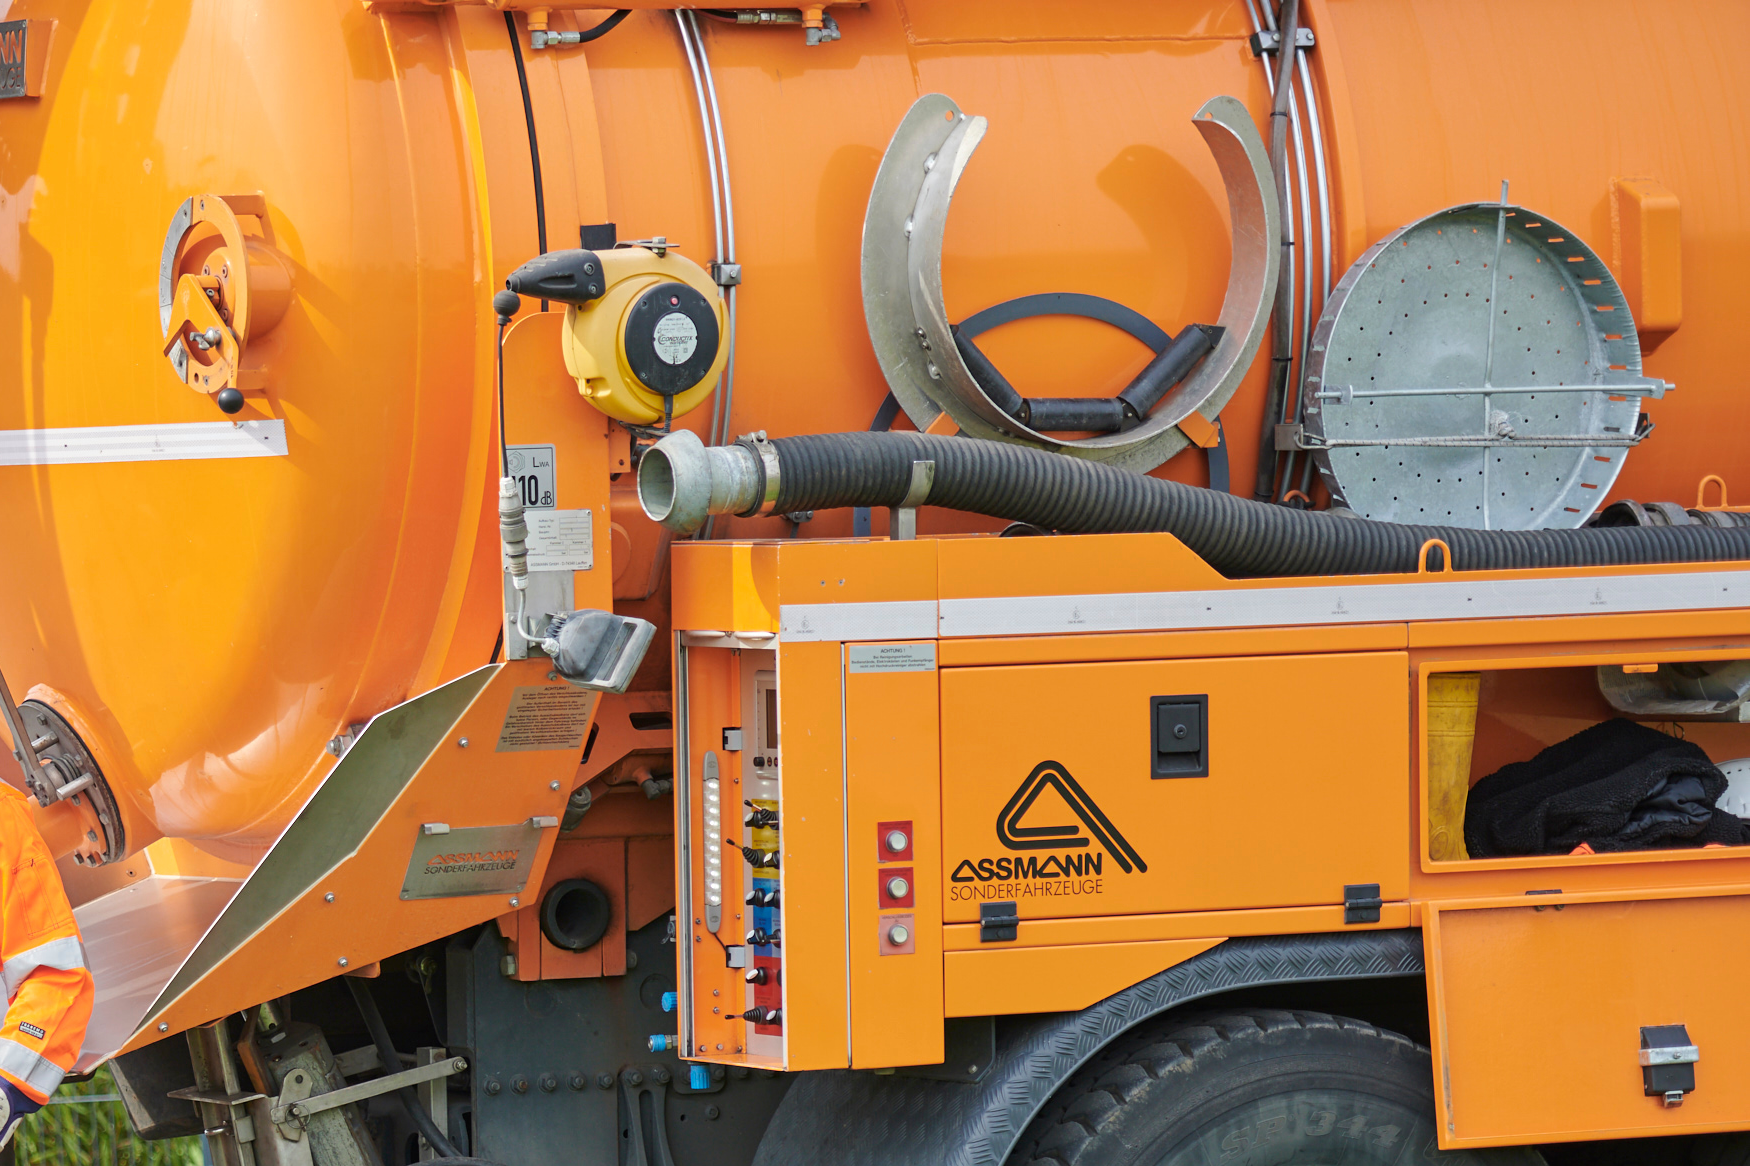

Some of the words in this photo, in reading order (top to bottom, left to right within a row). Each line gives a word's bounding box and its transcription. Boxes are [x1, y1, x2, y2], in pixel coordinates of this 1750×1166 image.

[512, 474, 539, 506] 10
[540, 490, 552, 506] dB
[424, 861, 517, 875] SONDERFAHRZEUGE
[427, 849, 520, 866] ASSMANN
[951, 852, 1103, 883] ASSMANN
[950, 879, 1103, 901] SONDERFAHRZEUGE
[1219, 1115, 1287, 1166] SP
[1304, 1110, 1402, 1149] 344
